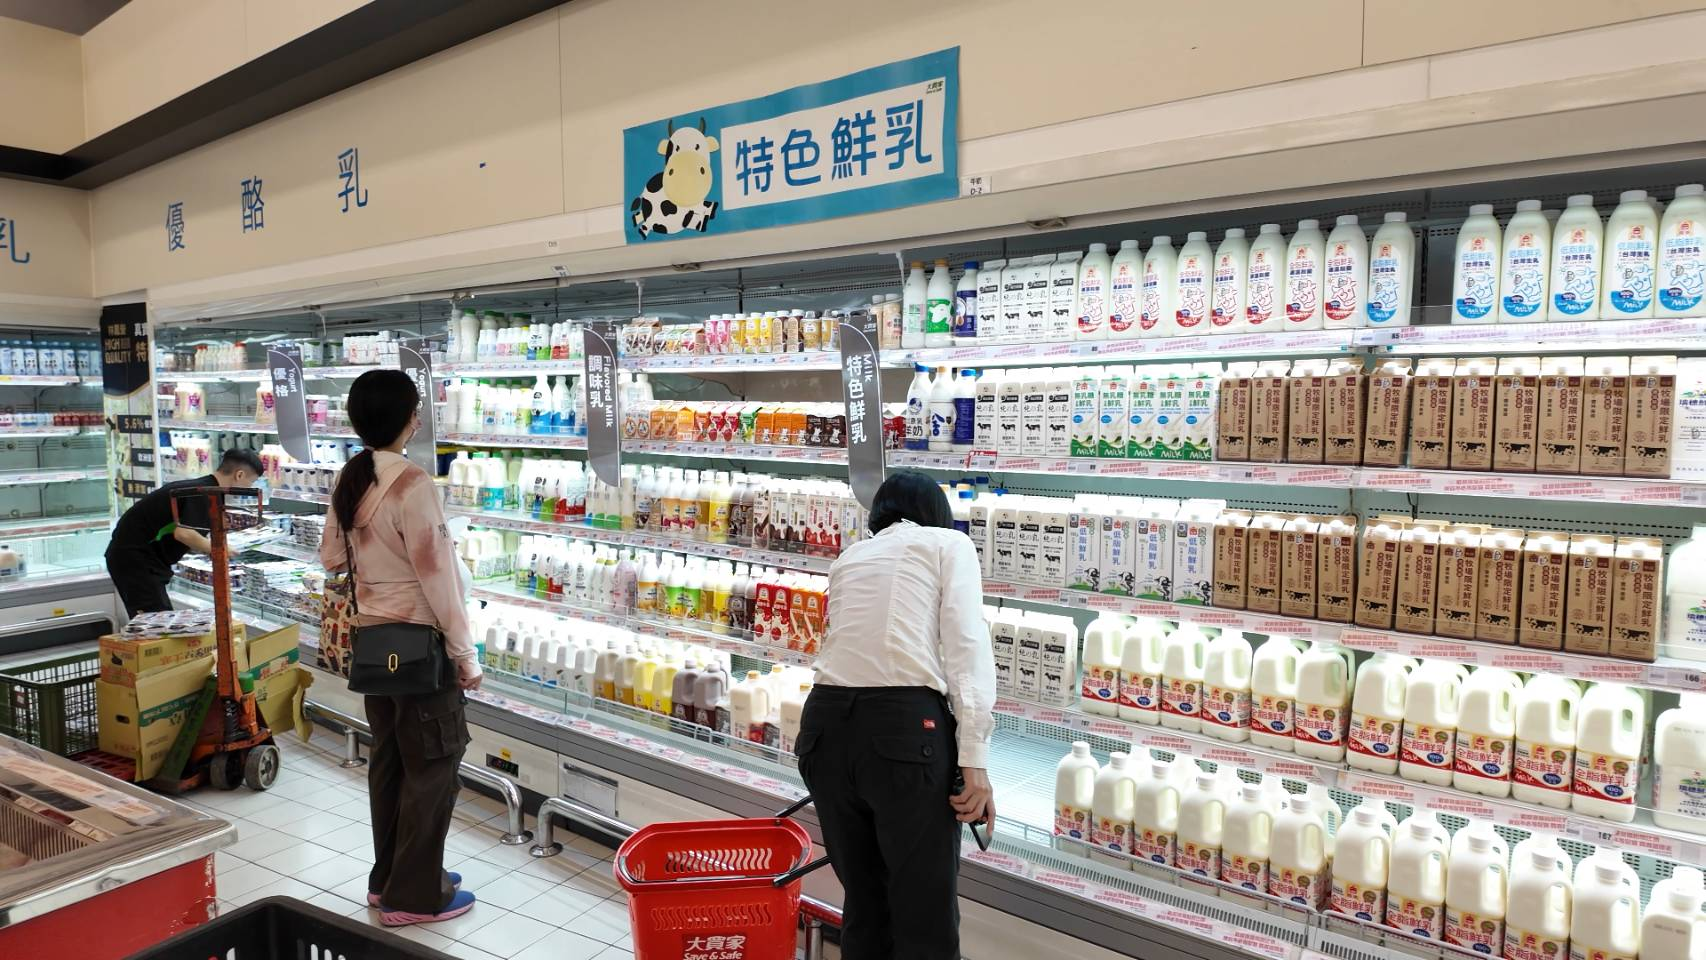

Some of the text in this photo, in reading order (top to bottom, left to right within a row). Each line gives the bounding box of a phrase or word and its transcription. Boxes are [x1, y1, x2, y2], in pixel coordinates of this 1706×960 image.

[736, 99, 932, 196] 特色鮮乳
[863, 354, 873, 383] Milk
[288, 367, 299, 393] Yogurt
[588, 355, 604, 408] 調味乳
[603, 355, 614, 428] Flavored Milk
[846, 354, 867, 444] 特色鮮乳
[1295, 717, 1336, 731] 全脂鮮乳
[1350, 728, 1394, 745] 全脂鮮乳
[1402, 738, 1448, 755] 全脂鮮乳
[1456, 748, 1505, 765] 全脂鮮乳
[1515, 757, 1566, 775] 全脂鮮乳
[1575, 768, 1629, 787] 全脂鮮乳
[1332, 894, 1376, 915] 全脂鮮乳
[1388, 910, 1435, 931] 全脂鮮乳
[685, 935, 746, 951] 大買家
[1446, 924, 1496, 946] 全脂鮮乳
[709, 951, 719, 960] &
[719, 950, 743, 960] Safe
